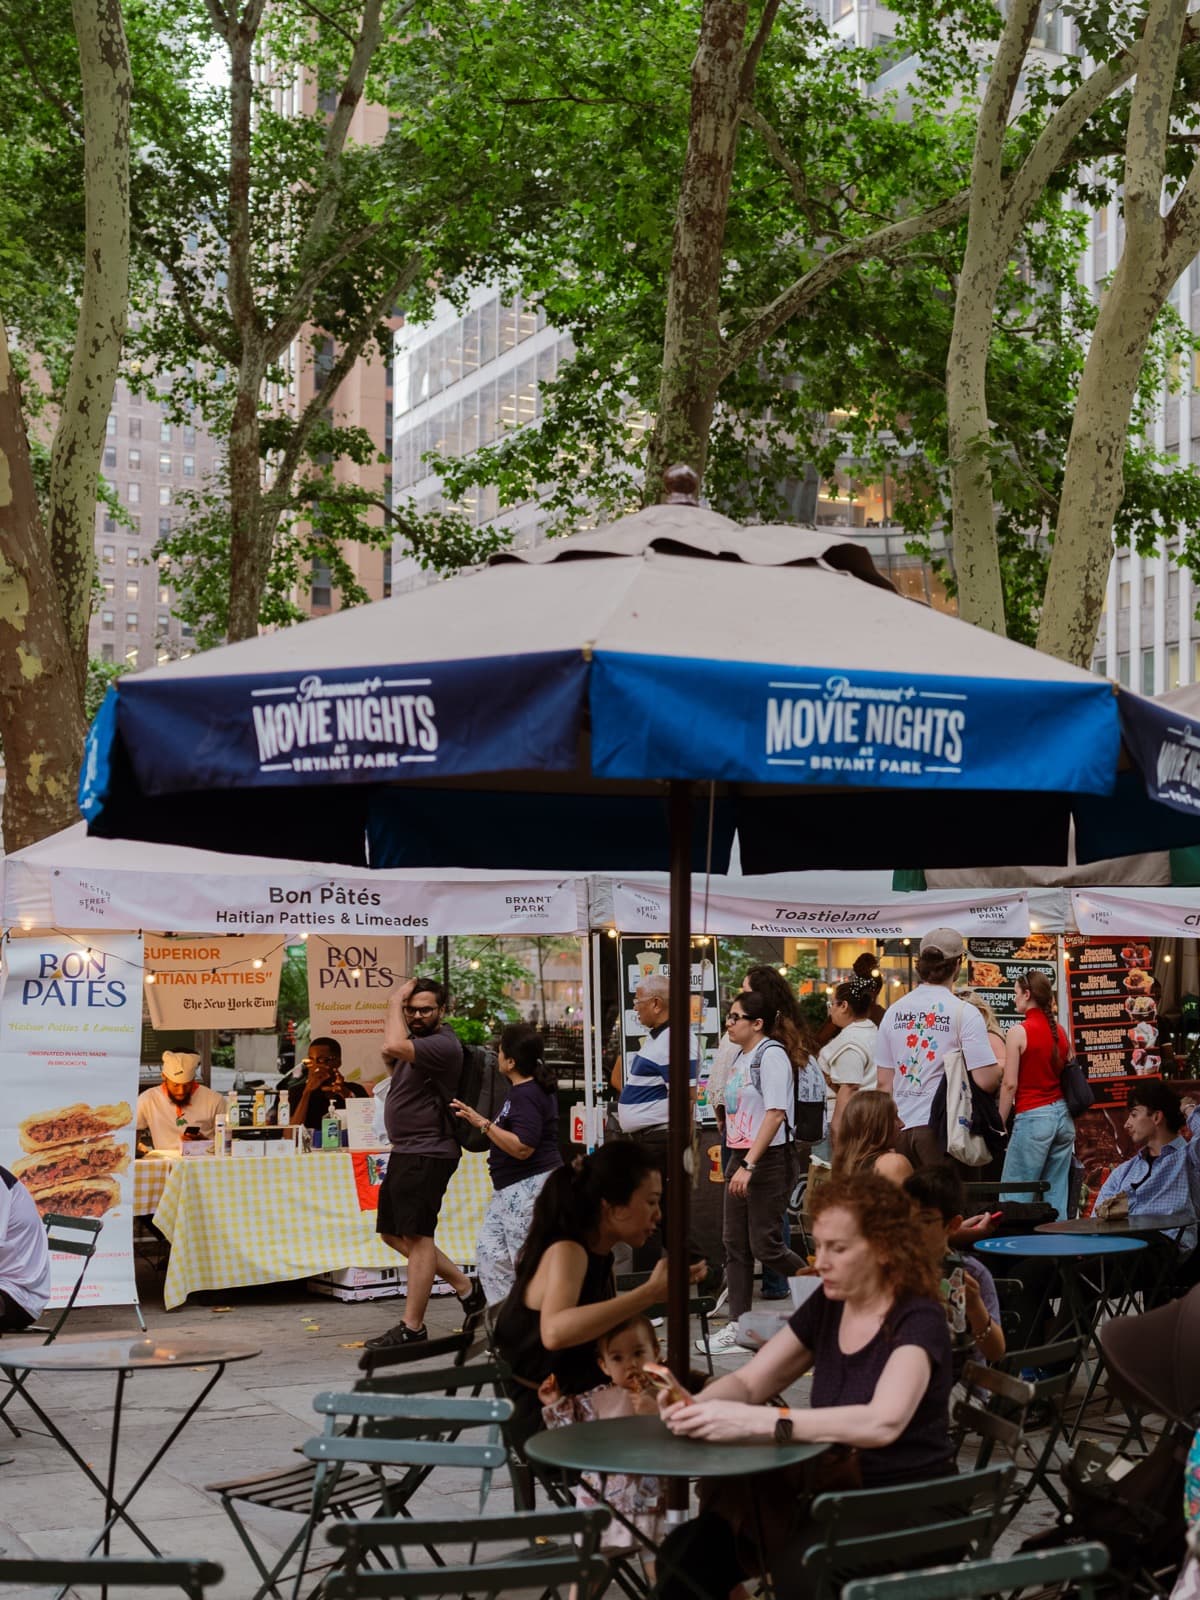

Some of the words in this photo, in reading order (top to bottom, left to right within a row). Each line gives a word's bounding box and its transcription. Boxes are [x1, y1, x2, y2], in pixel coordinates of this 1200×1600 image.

[252, 700, 333, 763] MOVIE
[336, 695, 438, 751] NIGHTS
[766, 698, 861, 755] MOVIE
[865, 703, 965, 764] NIGHTS
[292, 755, 350, 772] BRYANT
[353, 753, 398, 769] PARK
[810, 756, 875, 771] BRYANT
[880, 758, 922, 774] PARK
[269, 887, 311, 904] Bon
[320, 886, 381, 906] Pâtés
[505, 896, 552, 904] BRYANT
[775, 908, 880, 923] Toastieland
[969, 906, 1008, 914] BRYANT
[216, 911, 274, 924] Haitian
[279, 912, 335, 925] Patties
[341, 913, 351, 925] &
[355, 913, 429, 927] Limeades
[751, 923, 807, 934] Artisanal
[810, 926, 853, 934] Grilled
[859, 926, 903, 934] Cheese
[144, 947, 220, 960] SUPERIOR
[328, 947, 377, 967] BON
[39, 953, 106, 979] BON
[1006, 966, 1022, 974] MAC
[153, 972, 197, 984] ITIAN
[183, 999, 202, 1010] The
[203, 999, 225, 1009] New
[227, 998, 253, 1011] York
[254, 997, 276, 1008] Tim
[315, 1001, 352, 1011] Haitian
[355, 1000, 389, 1010] Limead
[895, 1011, 916, 1022] Nude
[919, 1012, 950, 1024] Pect
